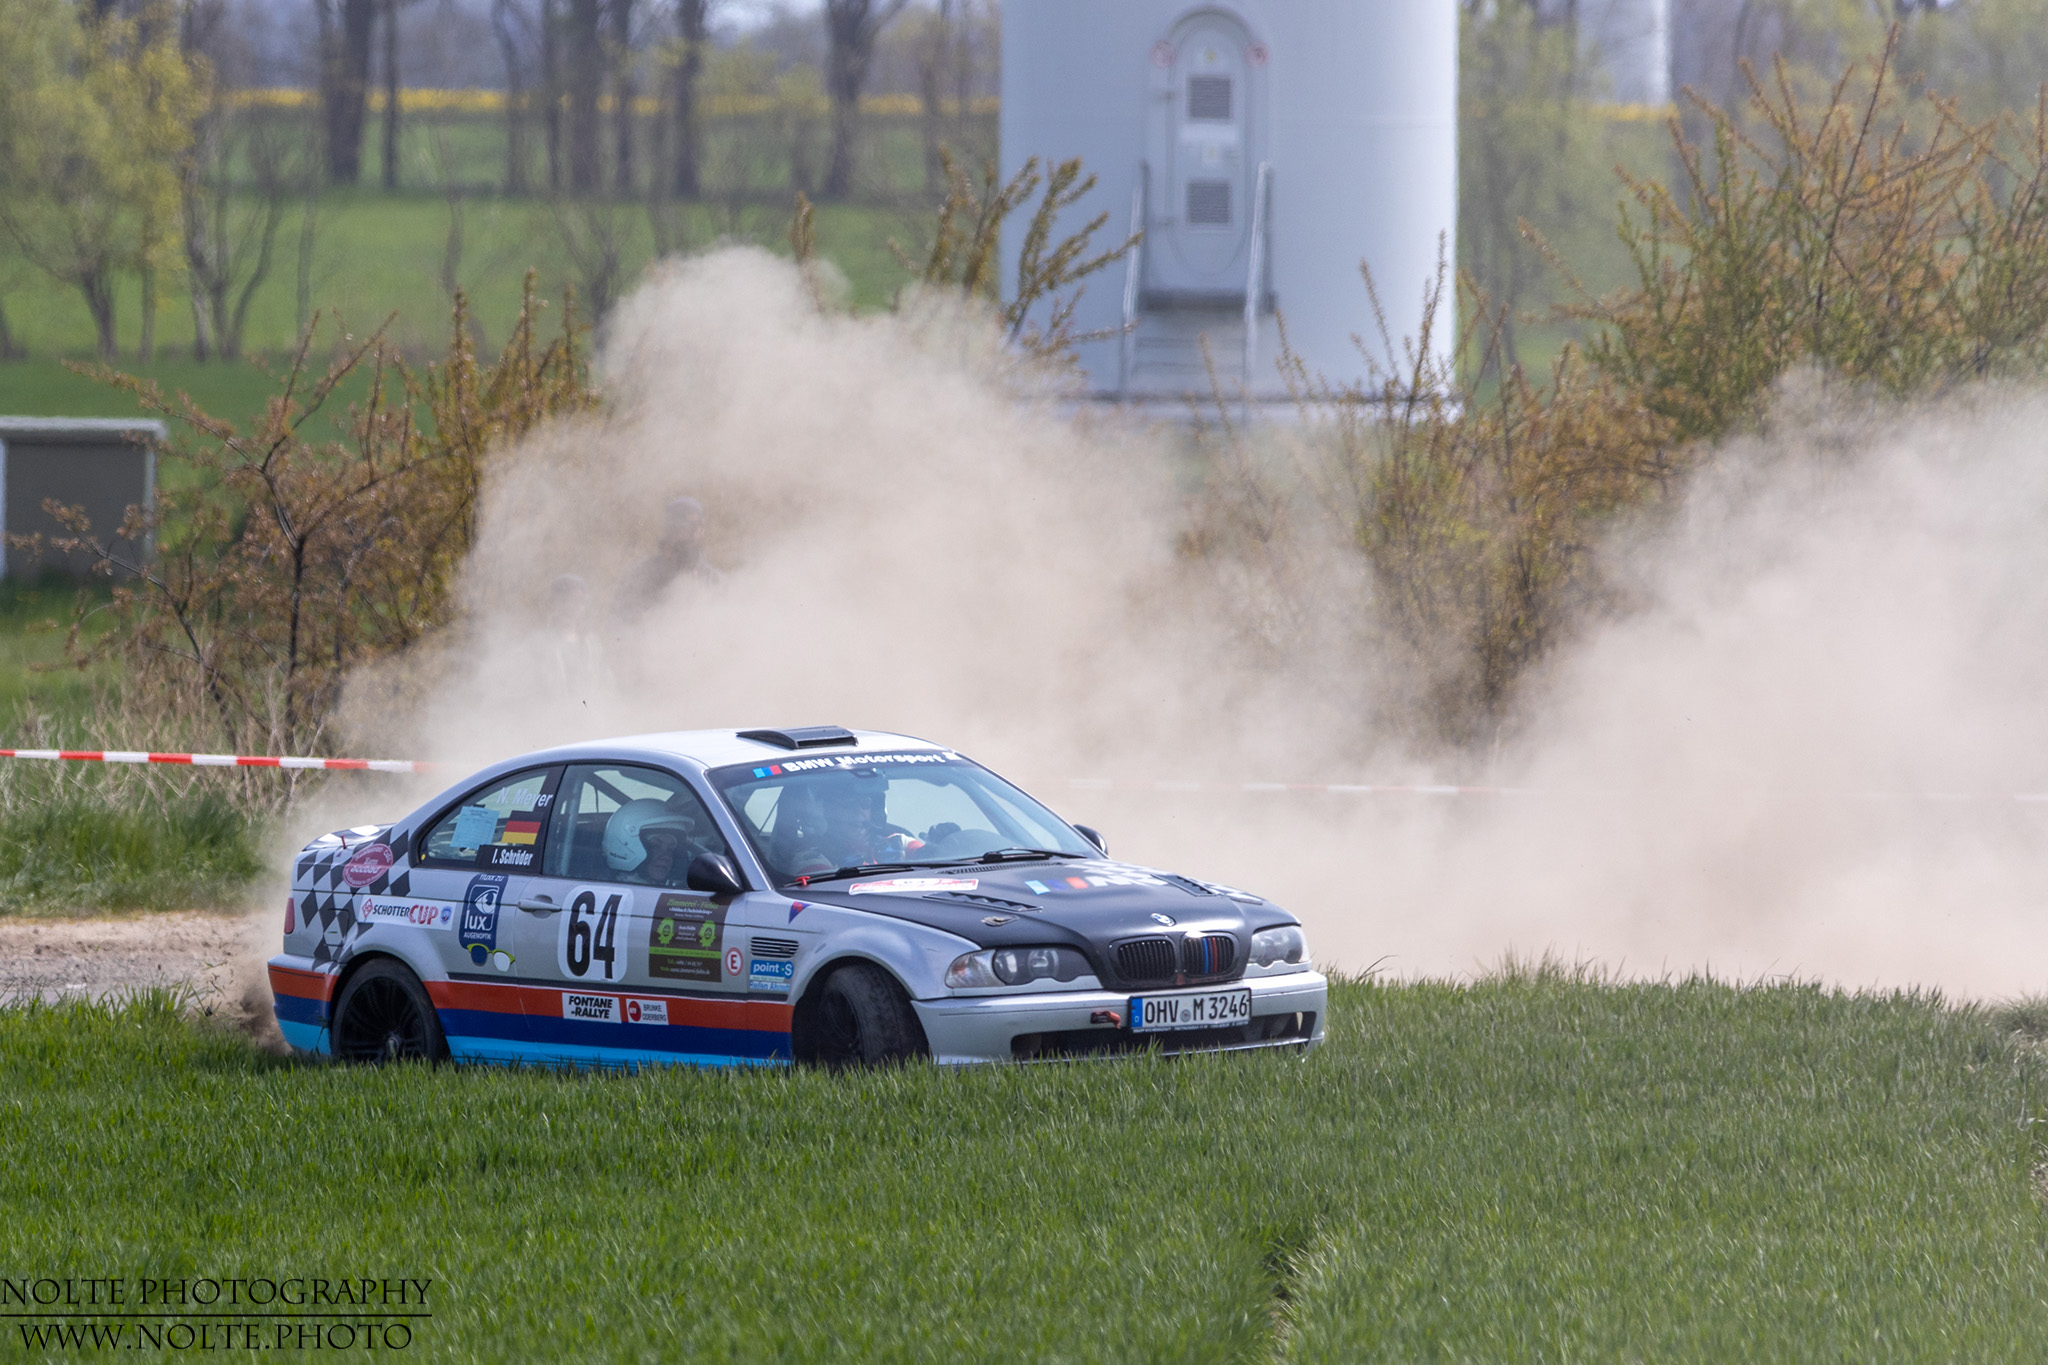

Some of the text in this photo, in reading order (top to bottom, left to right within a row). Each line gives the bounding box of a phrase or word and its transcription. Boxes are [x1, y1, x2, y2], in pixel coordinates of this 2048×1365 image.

[781, 754, 946, 772] BMW Motorsport
[496, 787, 554, 811] N. Meyer
[499, 848, 534, 866] Schröder
[464, 909, 487, 930] lux
[463, 931, 492, 940] AUGENOPTIK
[567, 890, 622, 979] 64
[730, 954, 738, 970] E
[753, 962, 780, 974] point
[569, 995, 613, 1009] FONTANE
[571, 1006, 610, 1019] -RALLYE
[1144, 1000, 1179, 1024] OHV
